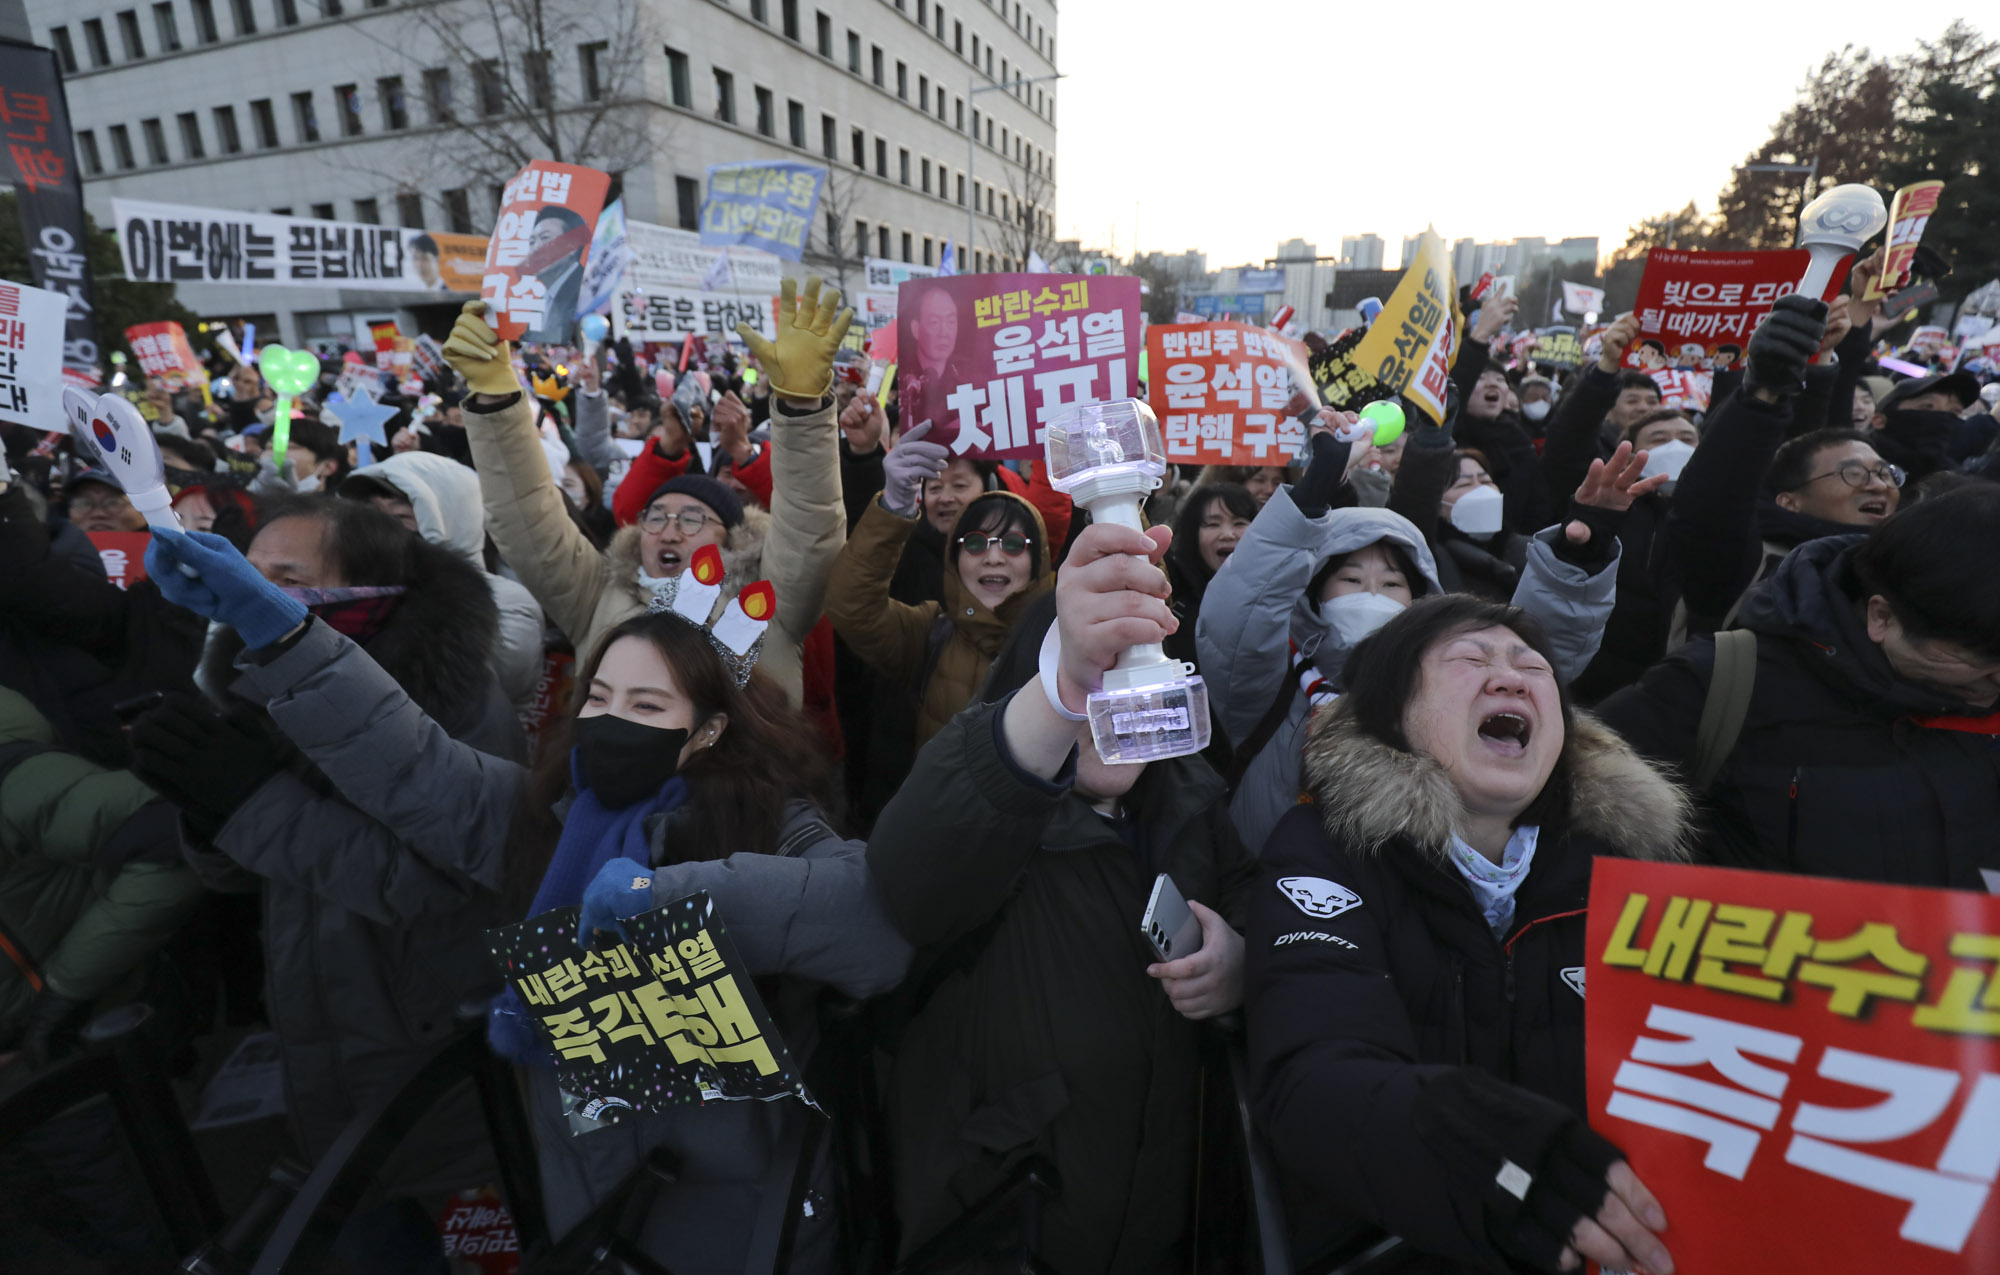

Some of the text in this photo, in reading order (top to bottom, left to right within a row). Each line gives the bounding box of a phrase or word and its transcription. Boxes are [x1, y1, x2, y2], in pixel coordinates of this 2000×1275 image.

[502, 170, 572, 206] 헌법
[127, 218, 274, 280] 이번에는
[703, 299, 764, 332] 답하라
[974, 280, 1089, 328] 반란수괴
[1662, 280, 1745, 307] 빛으로
[993, 308, 1126, 375] 윤석열
[1162, 329, 1238, 358] 반민주
[1640, 308, 1665, 334] 될
[1667, 311, 1748, 338] 때까지
[1165, 362, 1289, 409] 윤석열
[1165, 413, 1306, 459] 탄핵 구속
[1274, 931, 1359, 950] DYNAFIT
[517, 928, 726, 1006] 내란수괴 석열
[1605, 1004, 2000, 1254] 즉각
